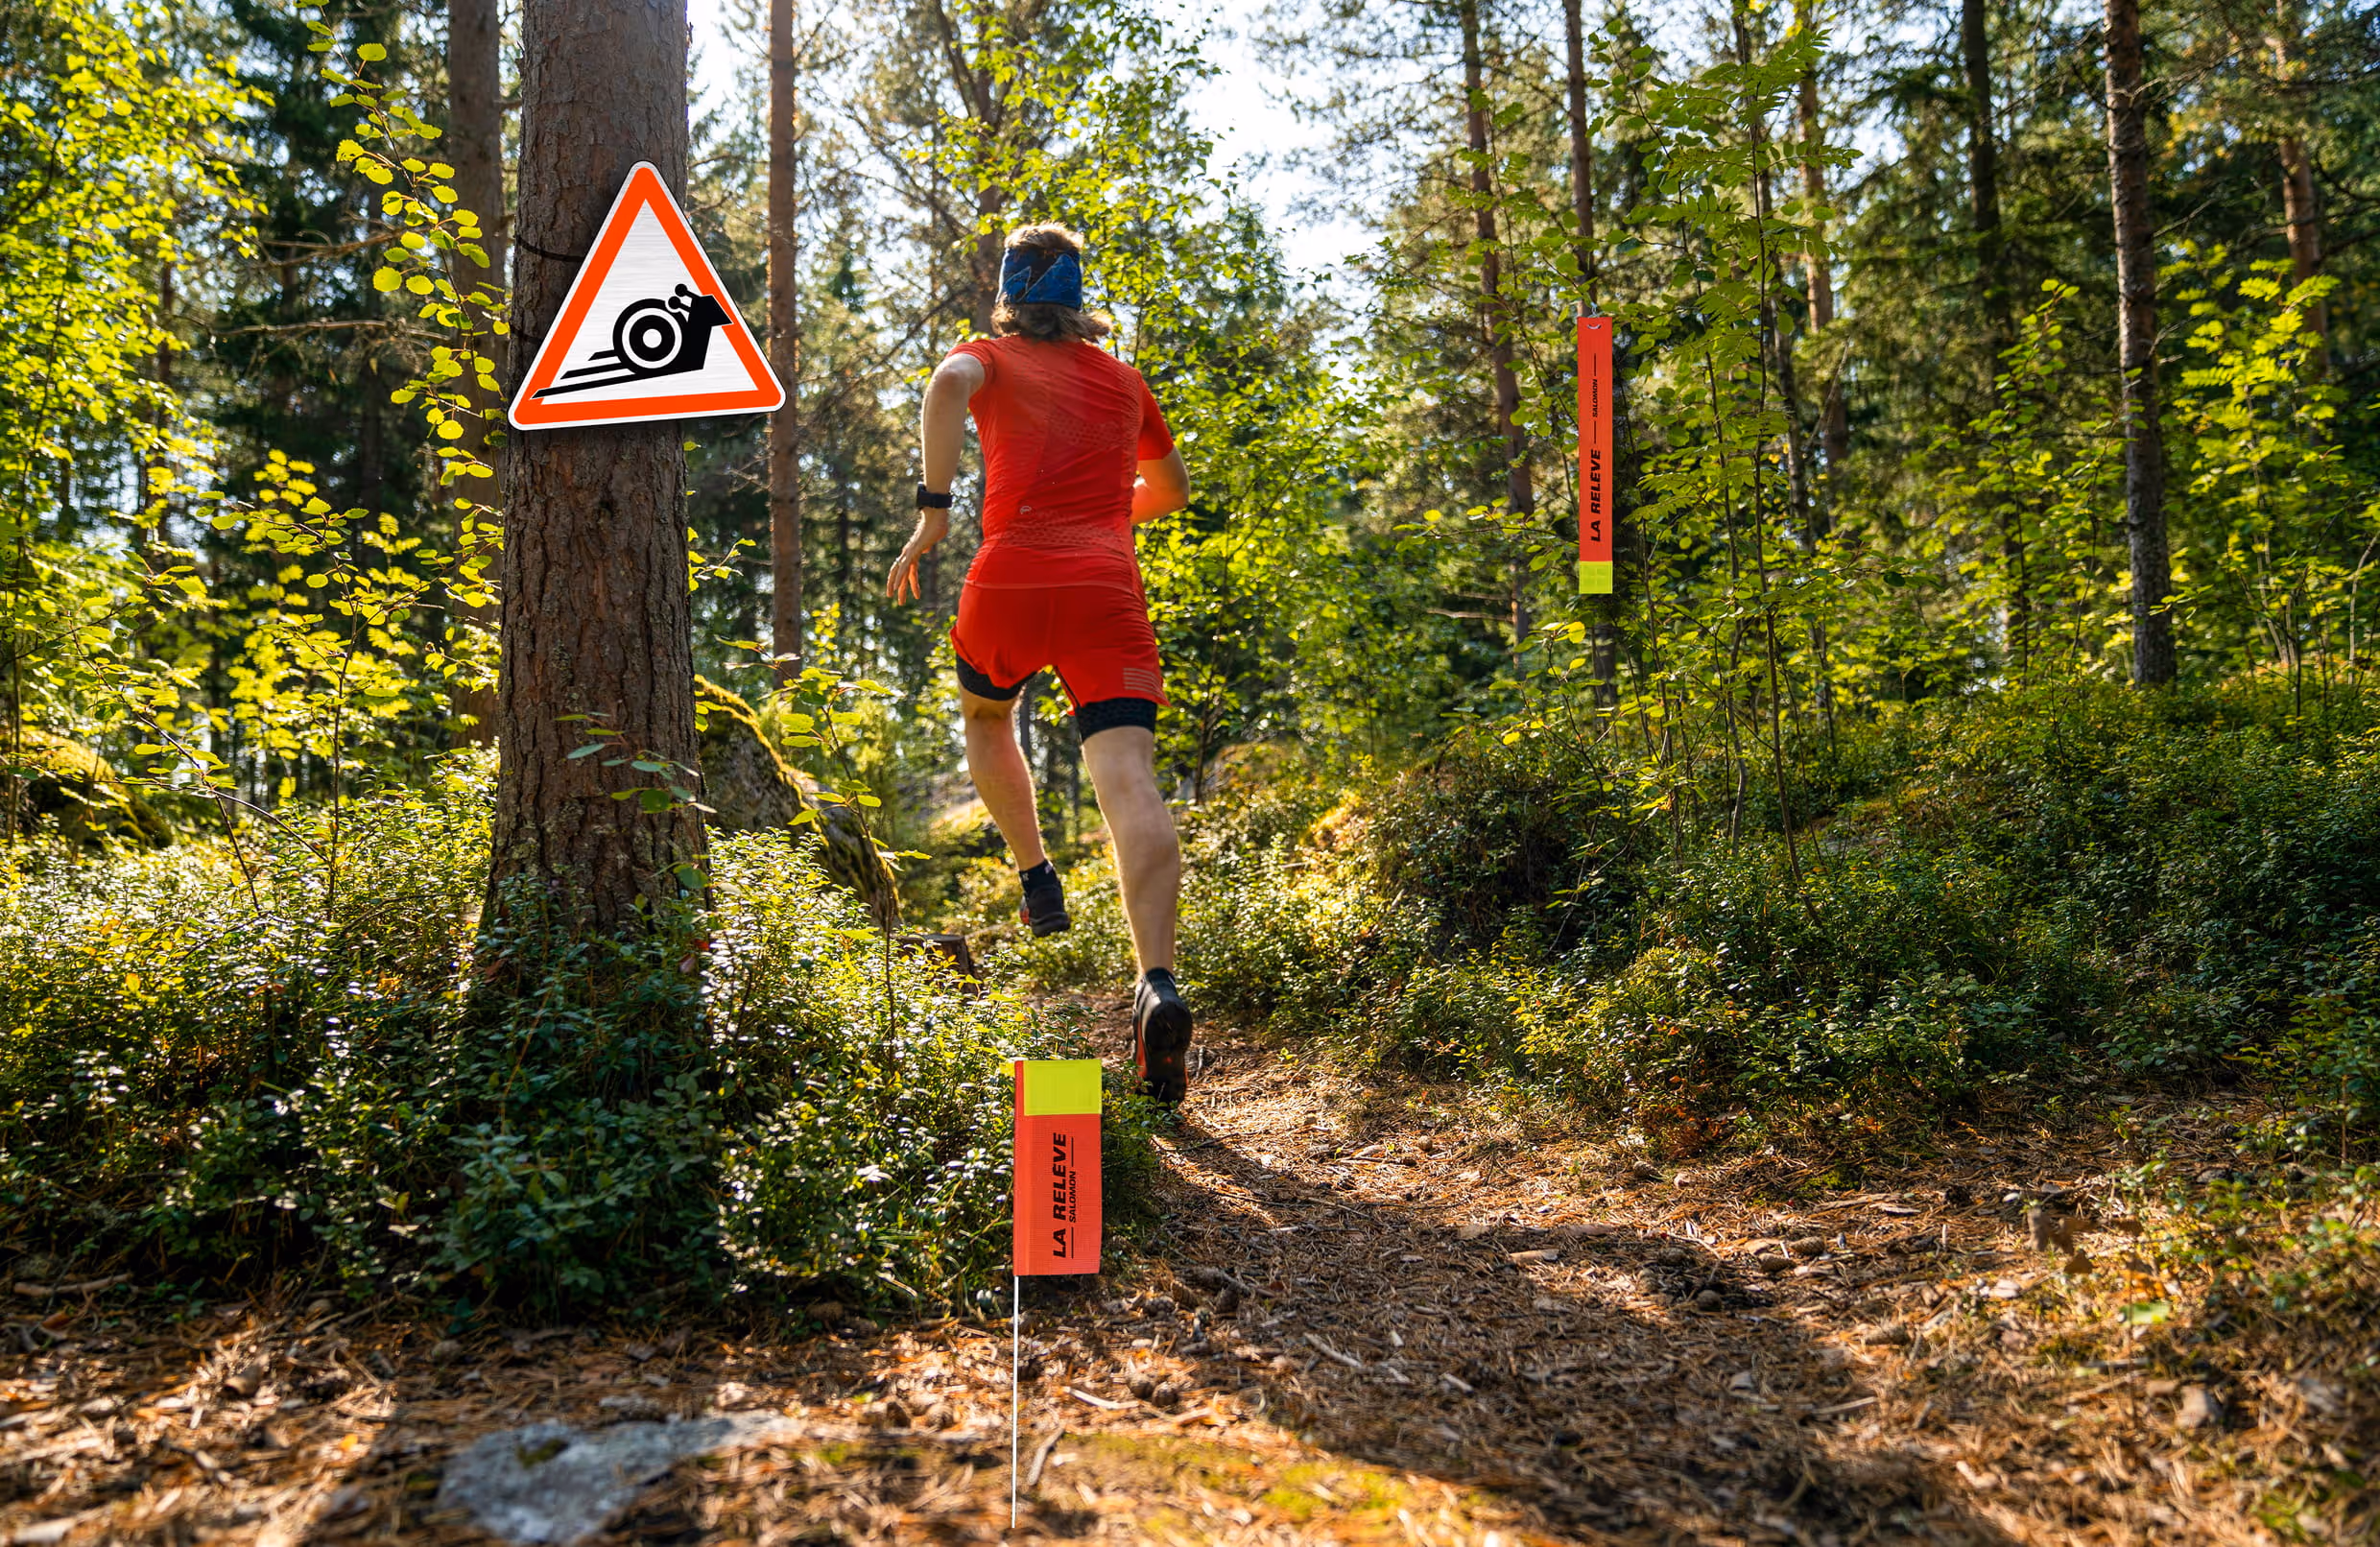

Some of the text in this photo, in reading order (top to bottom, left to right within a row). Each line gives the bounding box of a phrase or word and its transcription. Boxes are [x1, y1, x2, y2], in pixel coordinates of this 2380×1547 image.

[1590, 519, 1601, 542] LA
[1068, 1171, 1077, 1224] SALOMON
[1052, 1227, 1067, 1258] LA
